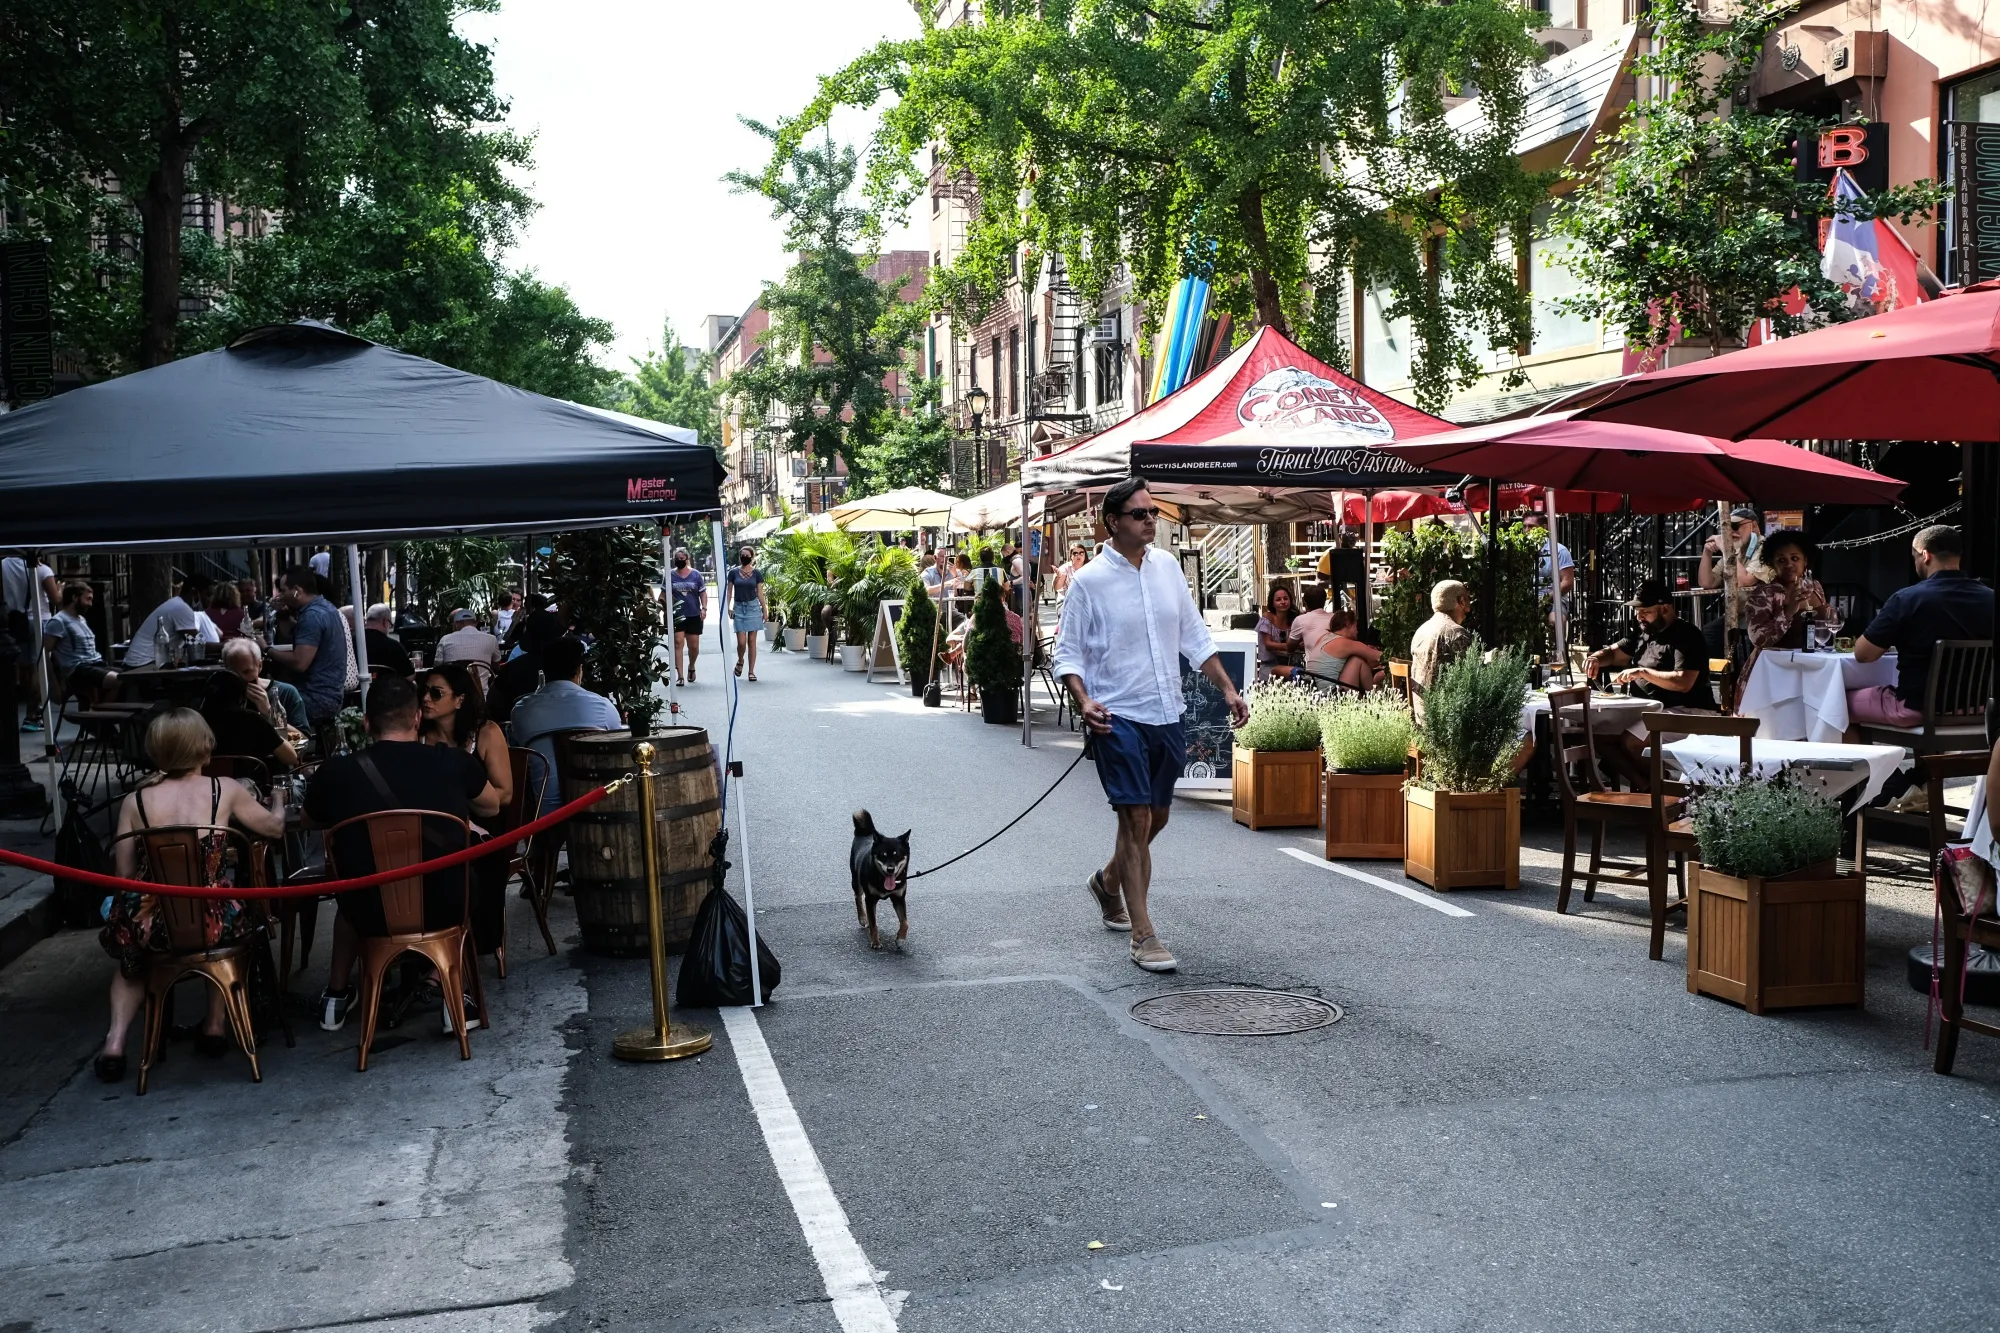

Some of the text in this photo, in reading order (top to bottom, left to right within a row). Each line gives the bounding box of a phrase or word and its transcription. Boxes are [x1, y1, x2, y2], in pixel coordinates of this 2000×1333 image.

[10, 331, 53, 400] CHIN
[1239, 385, 1363, 423] CONEY
[1256, 448, 1312, 473] THRILL
[1311, 445, 1351, 470] YOUR
[627, 477, 667, 499] Master
[641, 488, 677, 500] Canopy
